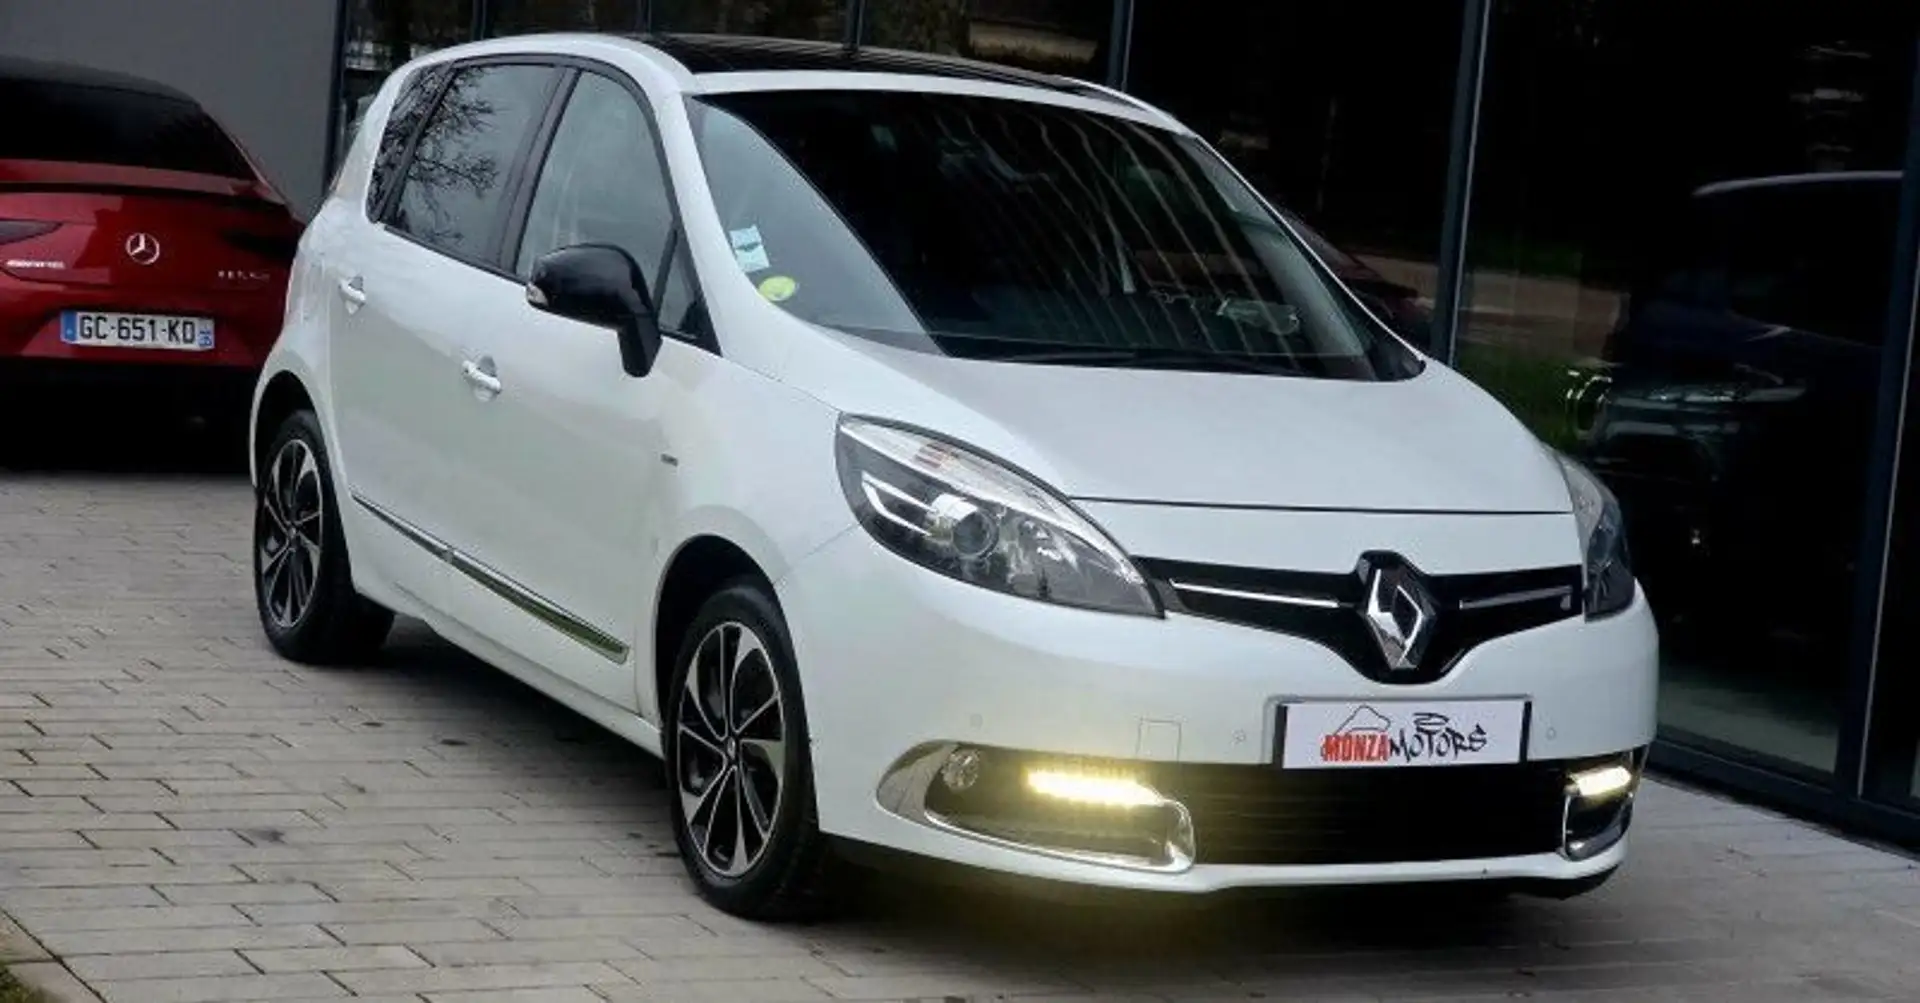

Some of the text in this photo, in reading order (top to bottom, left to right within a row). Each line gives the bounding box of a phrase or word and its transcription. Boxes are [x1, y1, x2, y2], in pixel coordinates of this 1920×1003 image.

[79, 316, 195, 344] GC-651-KD
[1321, 713, 1487, 763] MONZA MOTORS
